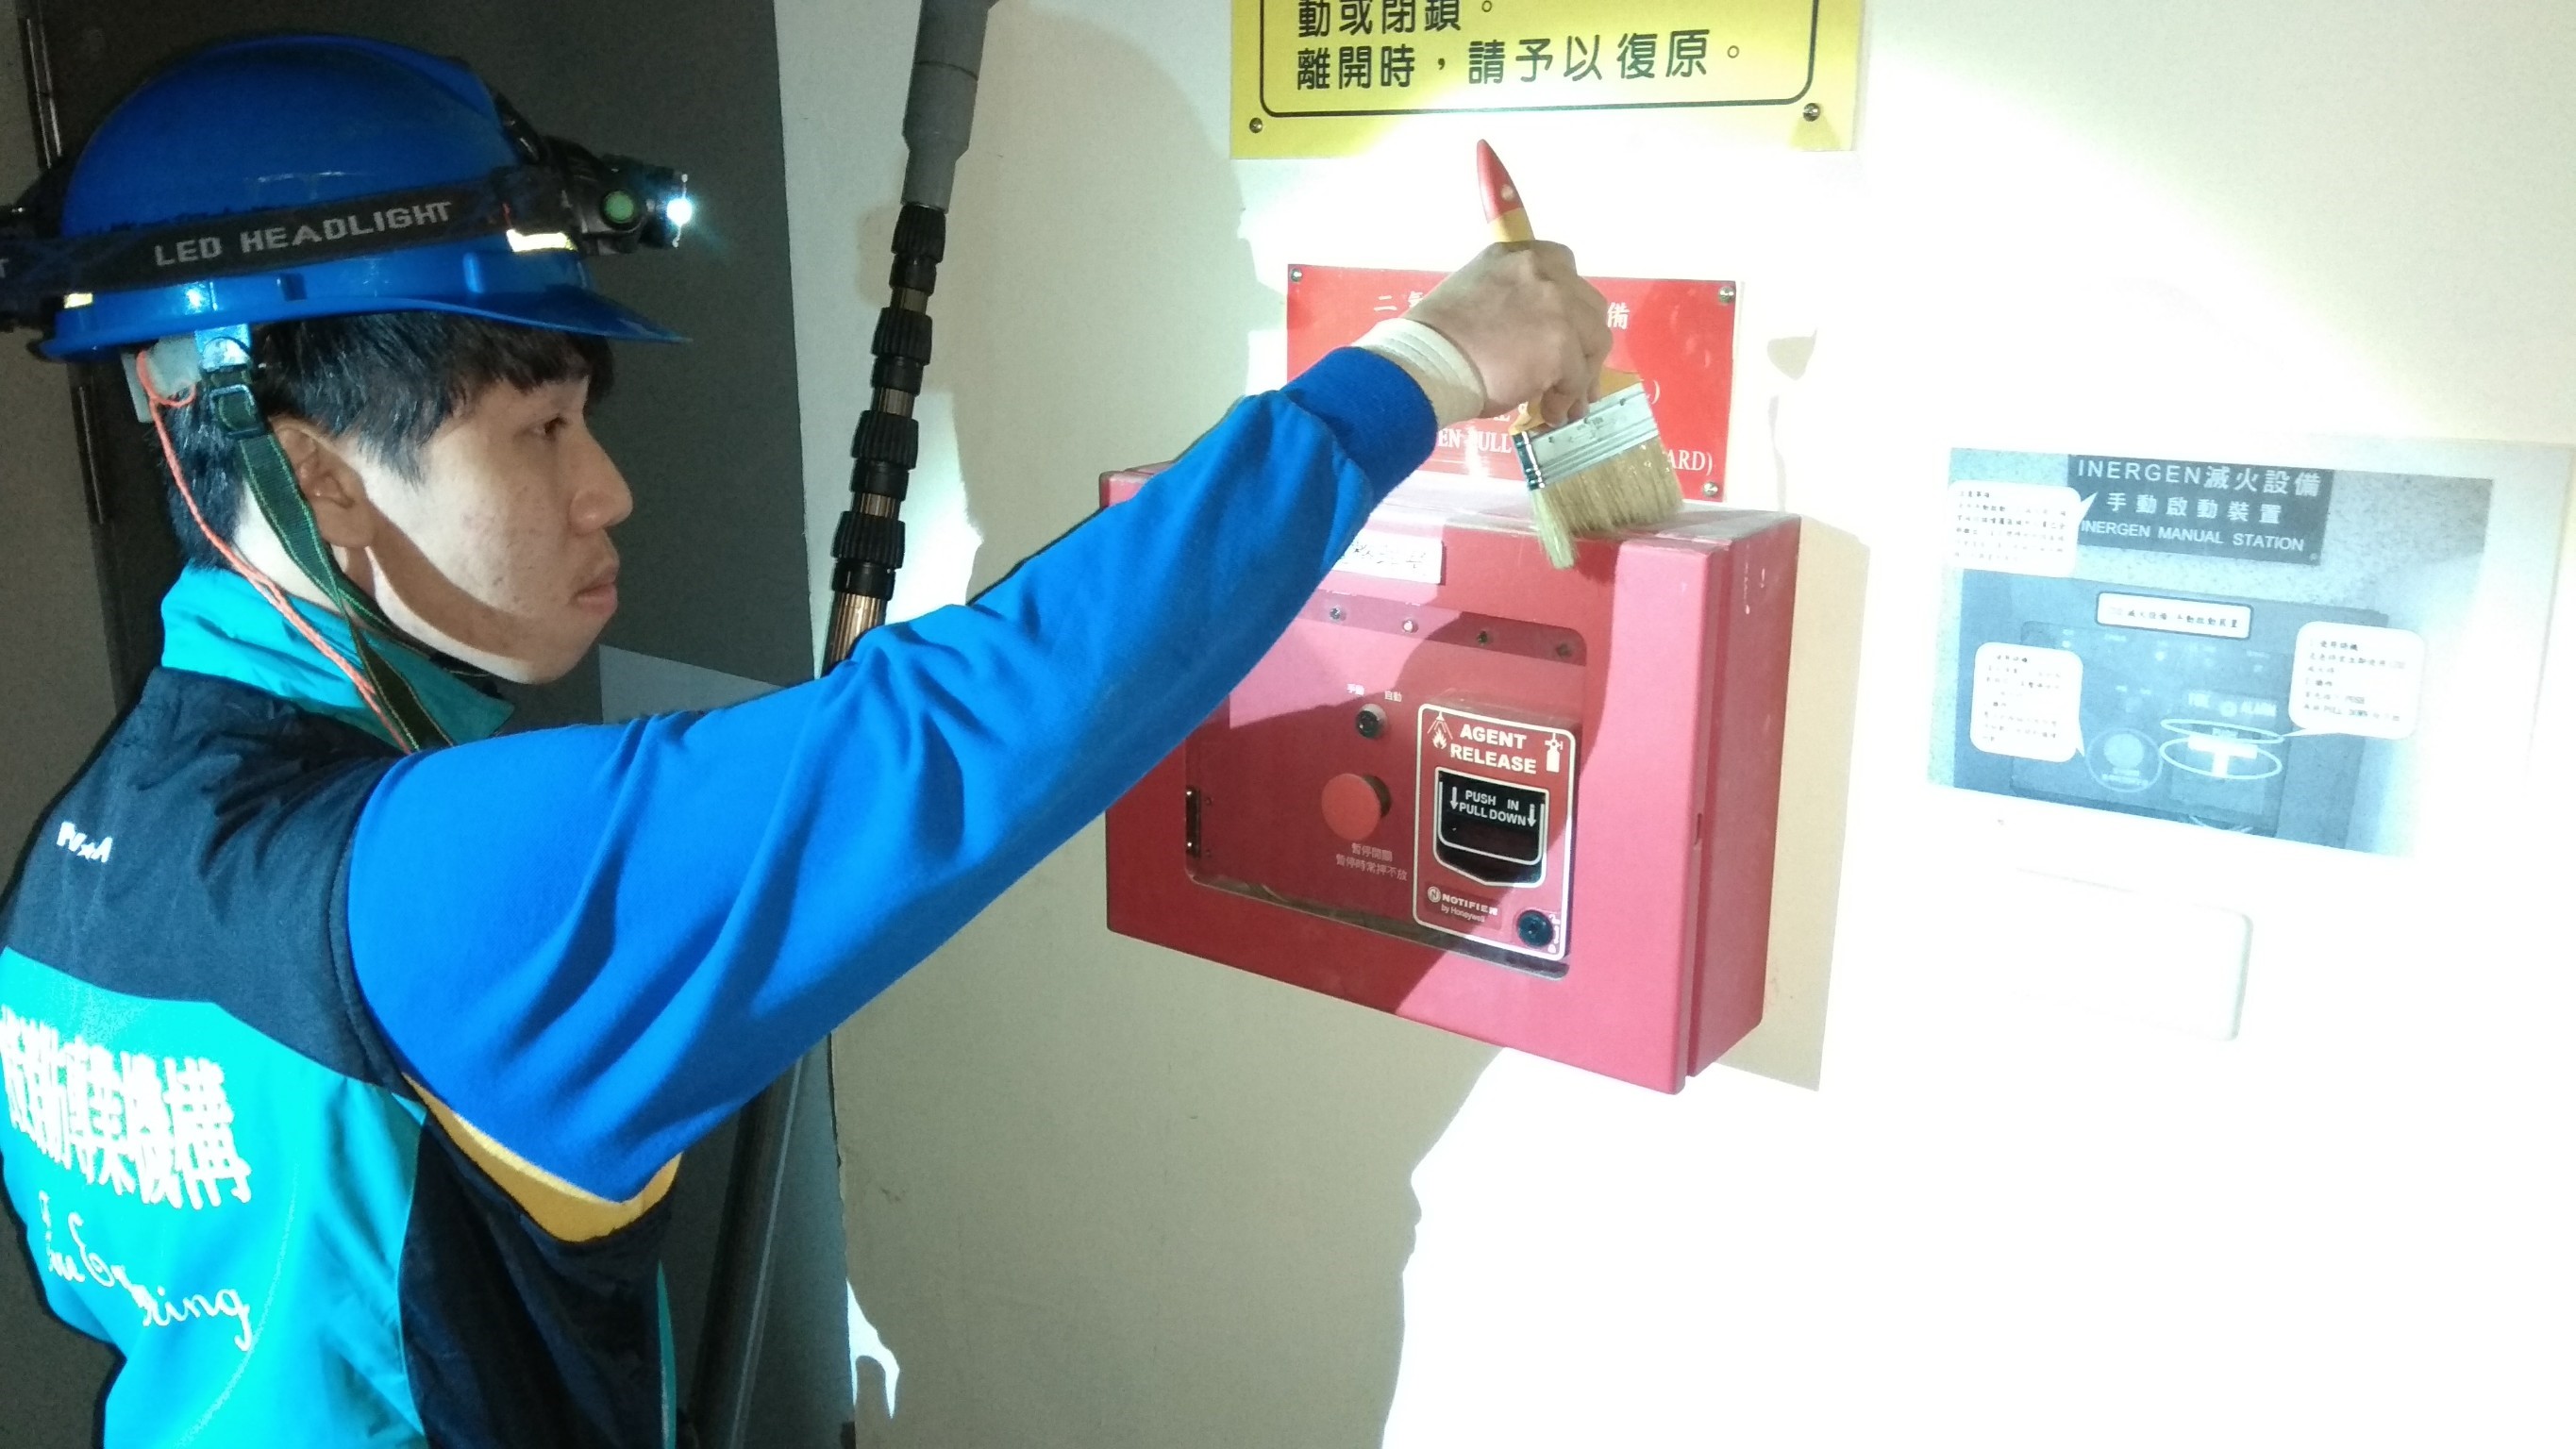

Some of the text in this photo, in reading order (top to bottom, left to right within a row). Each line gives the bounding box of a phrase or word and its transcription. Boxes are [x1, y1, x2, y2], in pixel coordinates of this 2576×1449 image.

[1296, 29, 1741, 92] 離開時，請予以復原。
[155, 201, 452, 267] LED HEADLIGHT
[2081, 520, 2151, 538] INERGEN
[2157, 526, 2224, 544] MANUAL
[2233, 533, 2305, 552] STATION
[1459, 723, 1528, 750] AGENT
[1449, 742, 1537, 775] RELEASE
[1459, 801, 1528, 826] PULL DOWN
[1464, 790, 1520, 811] PUSH IN
[1440, 903, 1486, 924] by Honeywell
[1441, 892, 1499, 917] NOTIFIER
